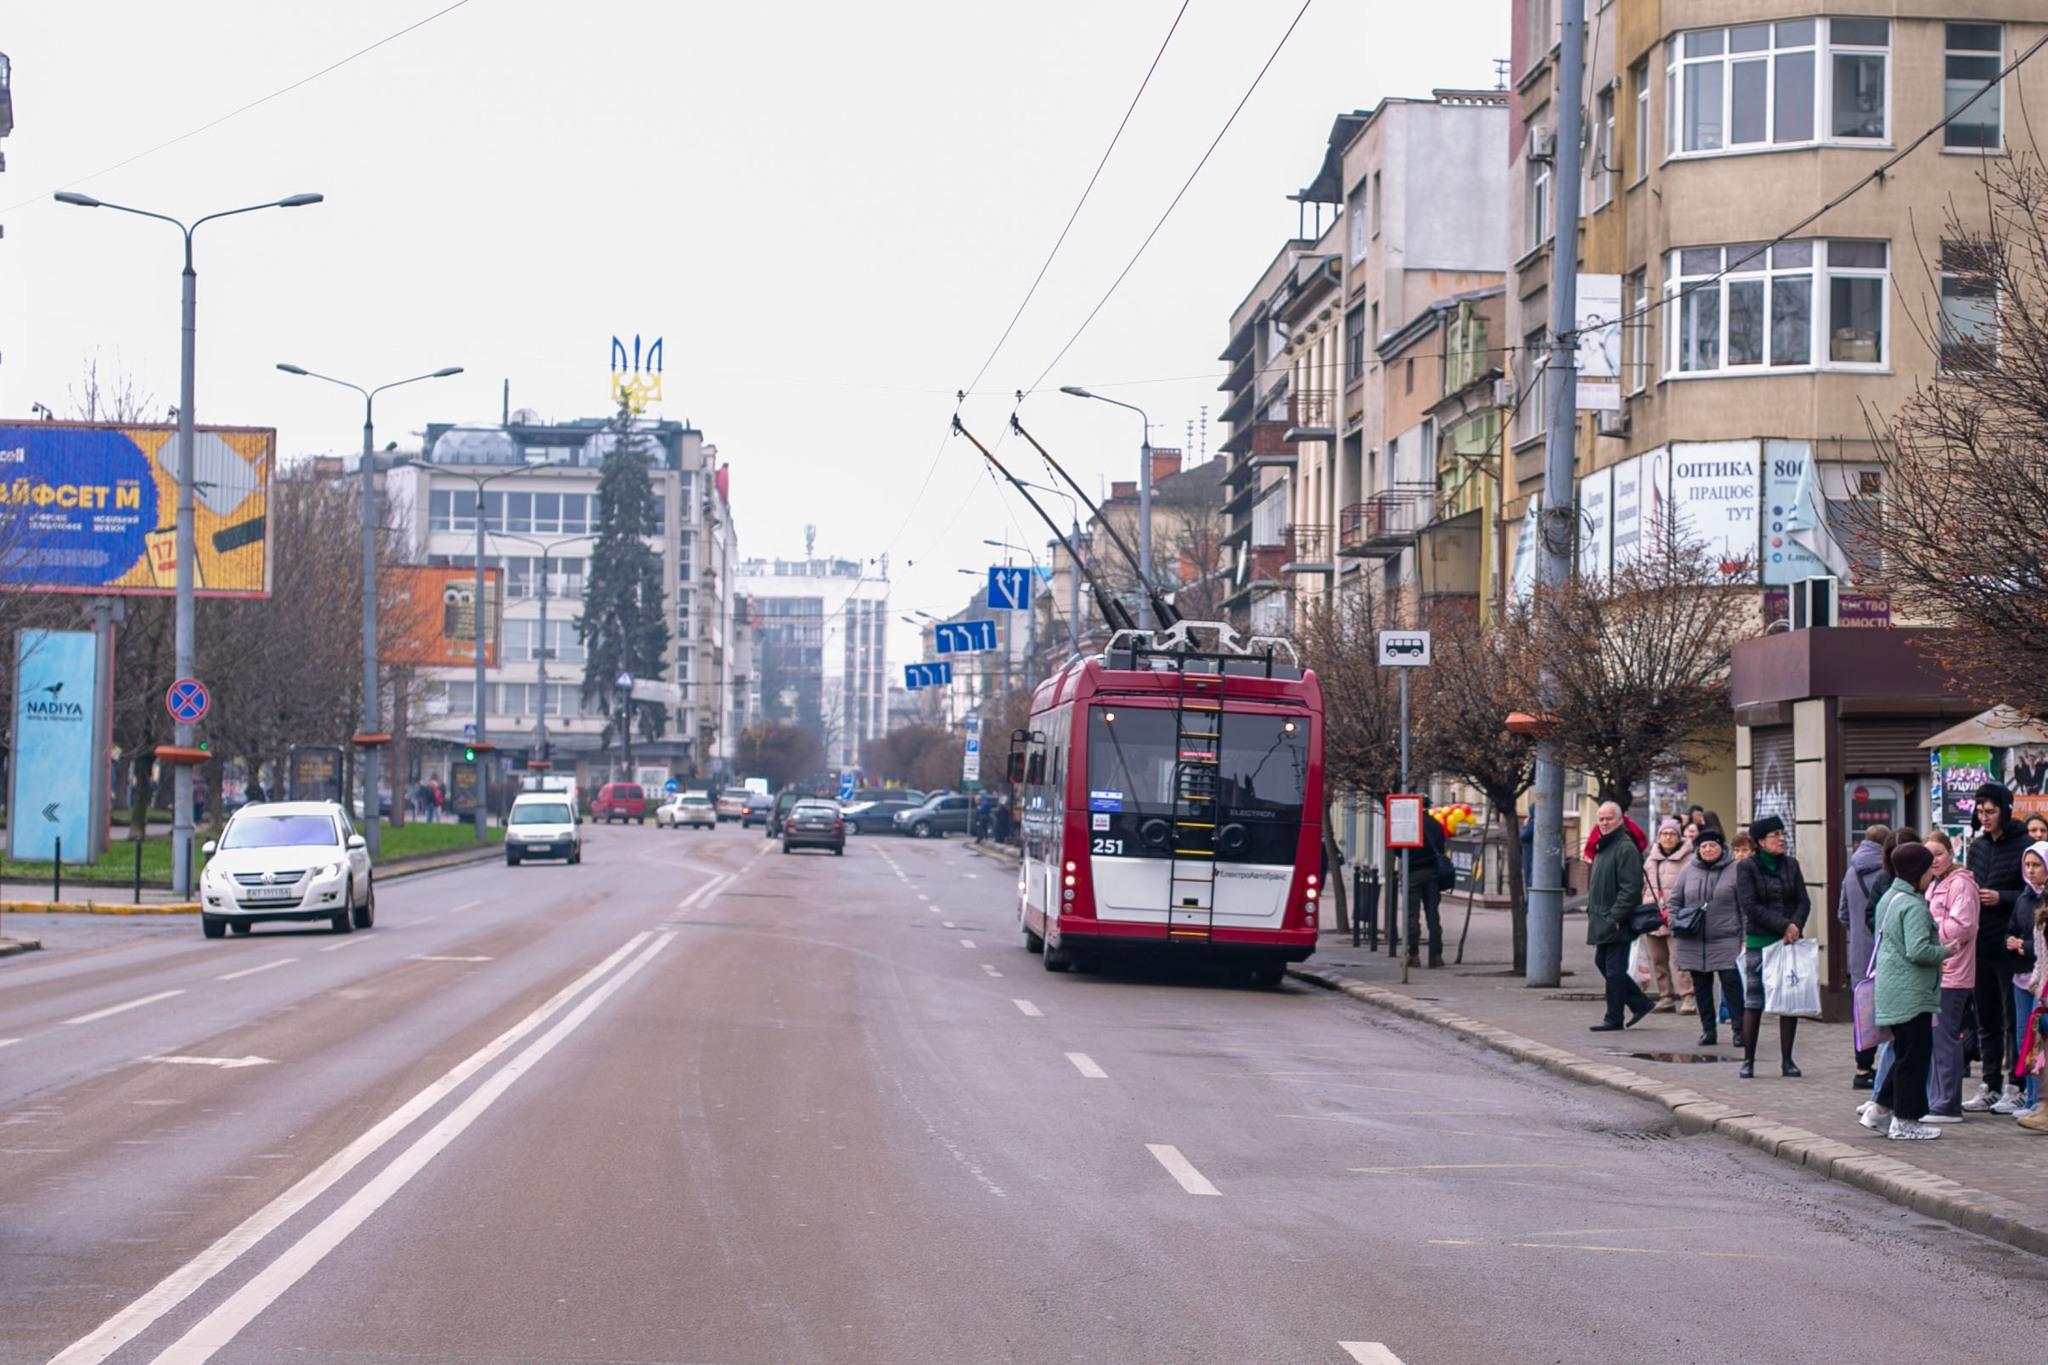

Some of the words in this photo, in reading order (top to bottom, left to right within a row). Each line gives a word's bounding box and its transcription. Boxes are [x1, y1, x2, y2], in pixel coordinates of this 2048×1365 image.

[1677, 461, 1753, 478] ОПТИКА
[116, 487, 140, 509] М
[1689, 485, 1754, 502] ПРАЦЮЄ
[1726, 507, 1754, 521] ТУТ
[27, 702, 83, 715] NADIYA
[1230, 809, 1276, 818] ELECTRON
[1092, 838, 1123, 854] 251
